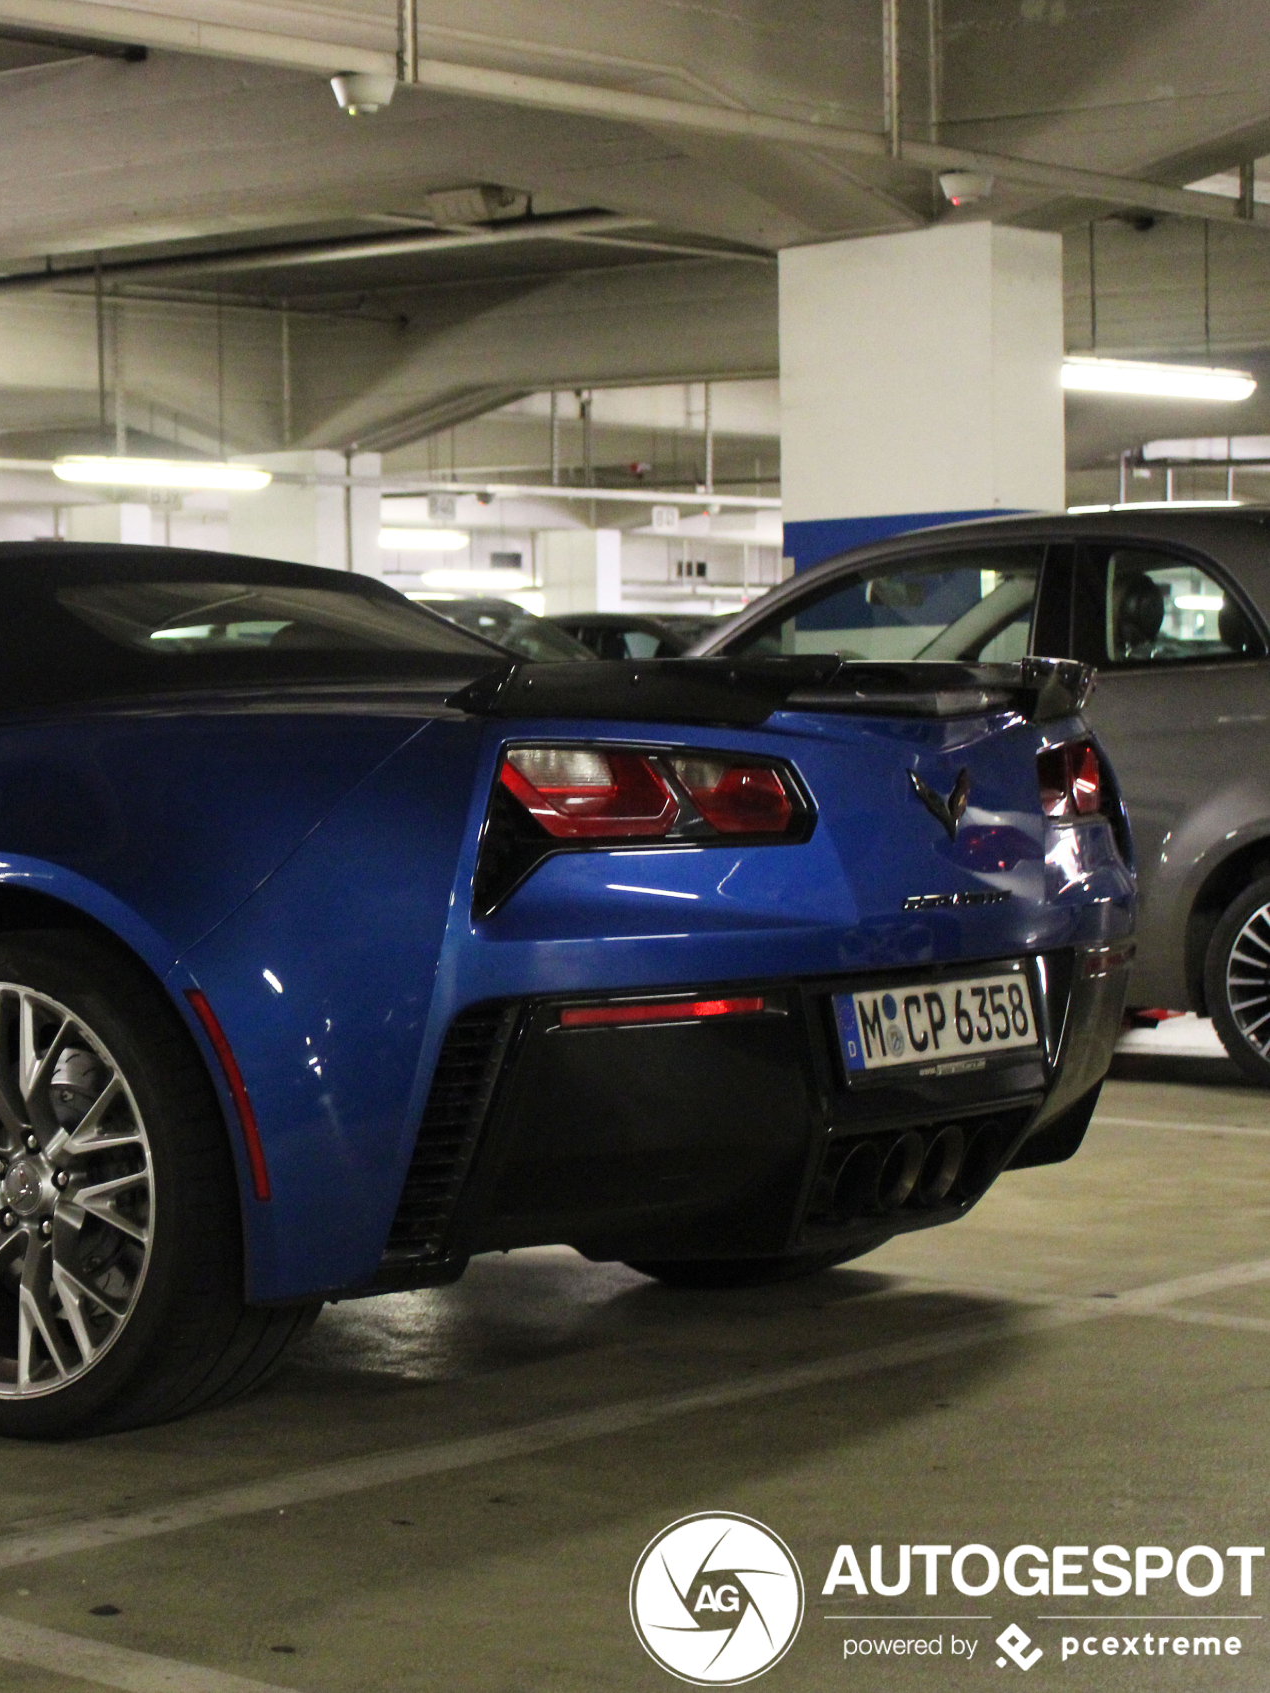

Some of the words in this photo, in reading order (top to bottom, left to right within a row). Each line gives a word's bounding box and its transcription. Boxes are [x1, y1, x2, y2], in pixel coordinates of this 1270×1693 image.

[858, 999, 887, 1058] M
[903, 991, 946, 1052] CP
[954, 982, 1029, 1045] 6358
